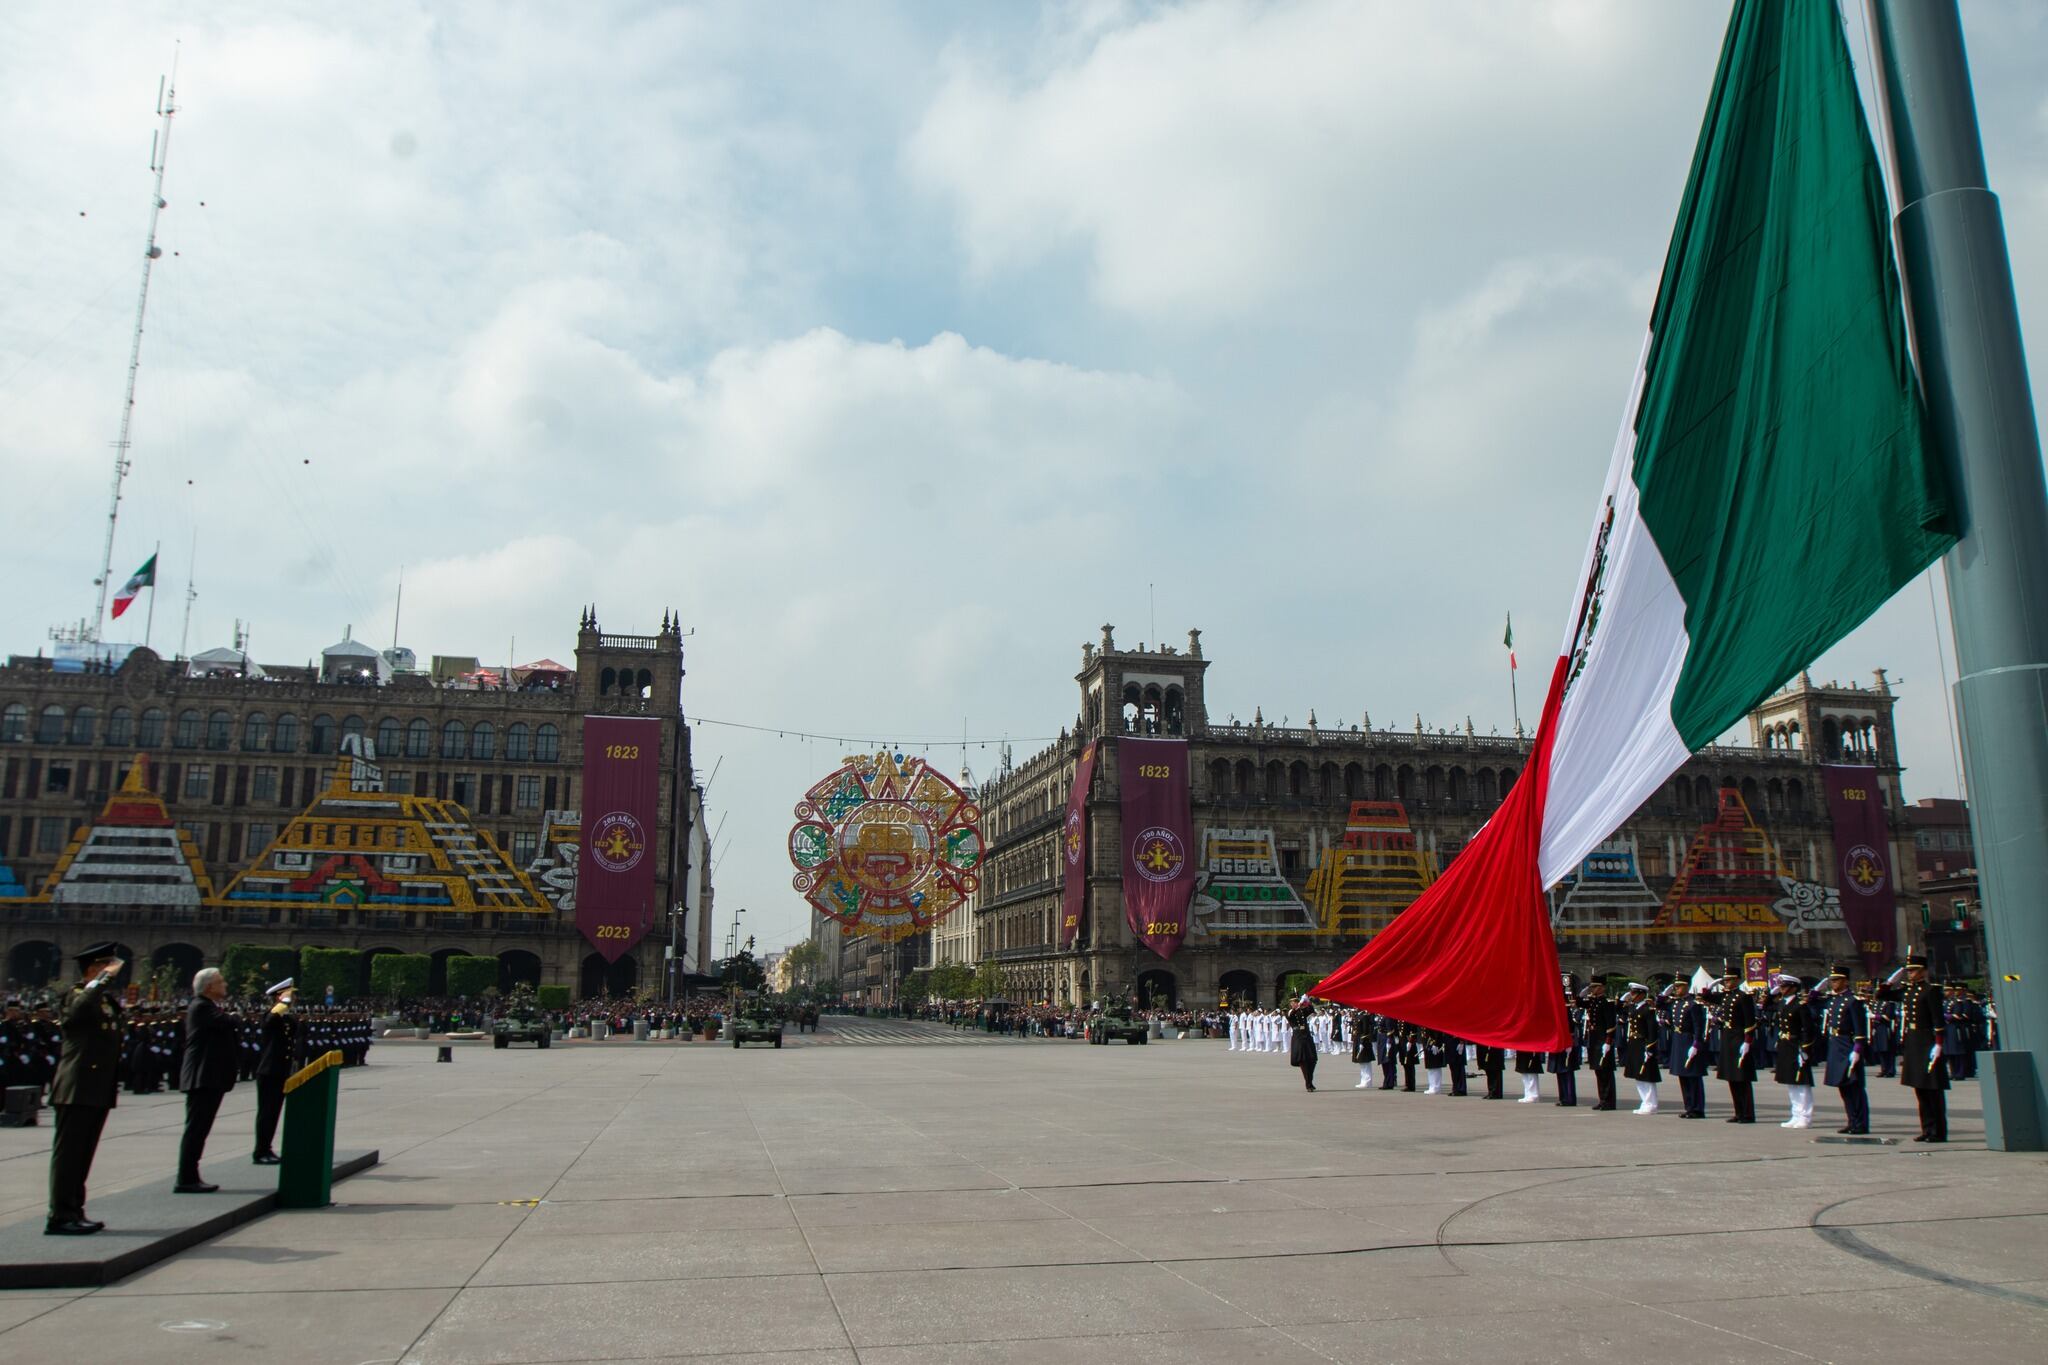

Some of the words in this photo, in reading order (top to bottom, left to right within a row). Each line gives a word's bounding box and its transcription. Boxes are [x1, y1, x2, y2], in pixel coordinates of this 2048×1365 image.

[606, 744, 639, 760] 1823
[1139, 764, 1170, 778] 1823
[1842, 788, 1866, 801] 1823
[603, 817, 616, 827] 200
[1142, 831, 1155, 841] 200
[1156, 830, 1175, 842] AÑOS
[596, 925, 631, 939] 2023
[1147, 922, 1178, 935] 2023
